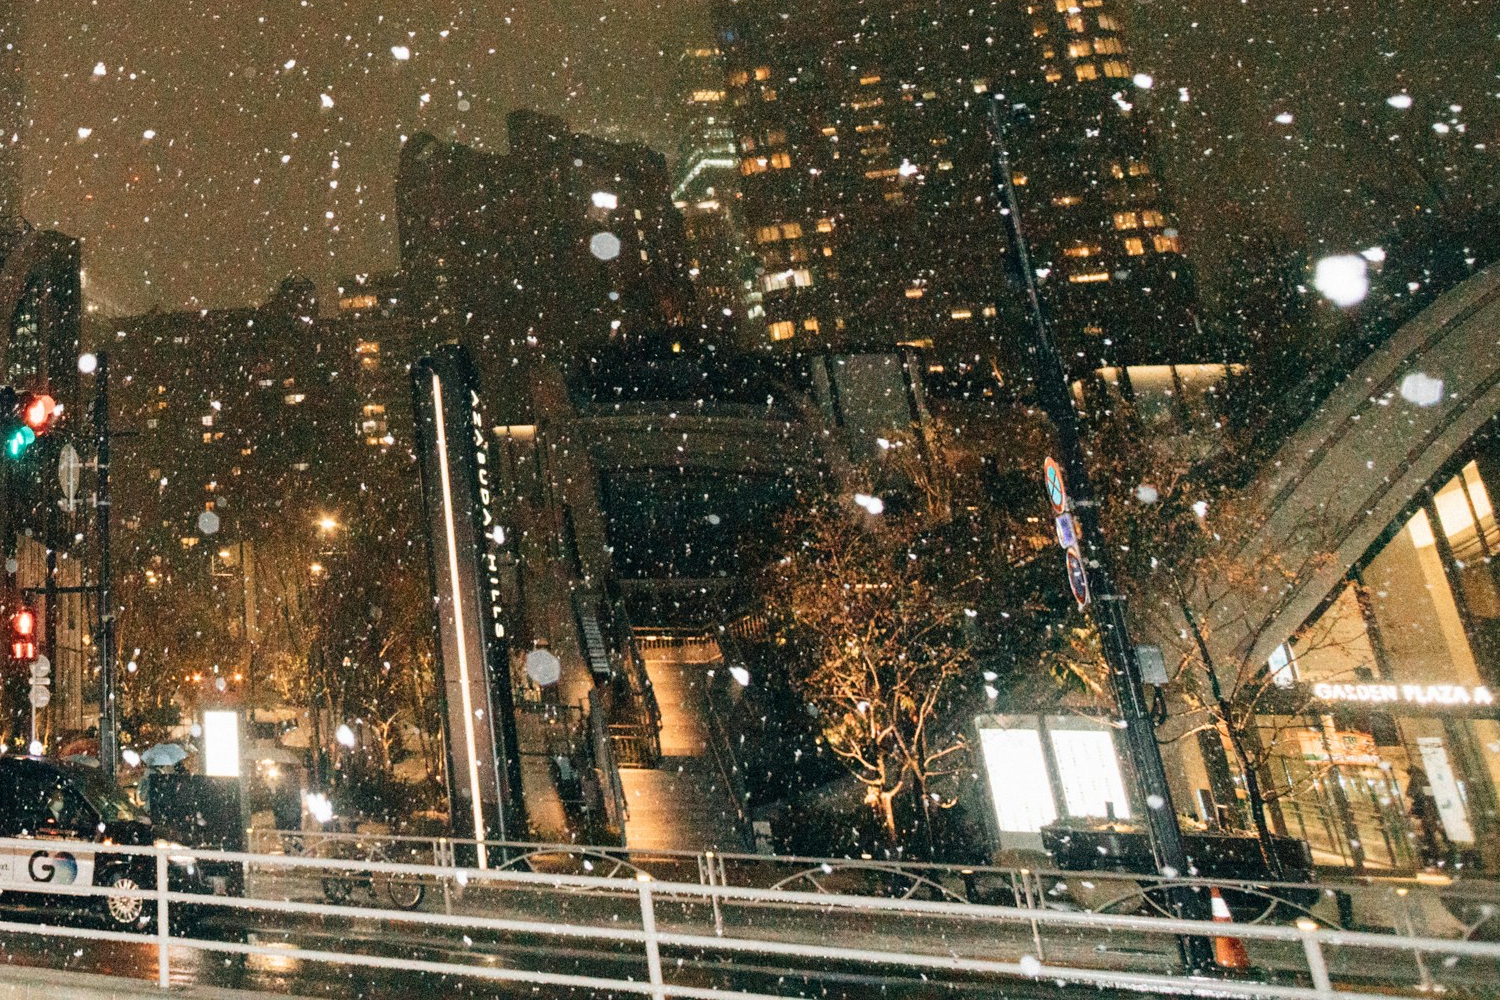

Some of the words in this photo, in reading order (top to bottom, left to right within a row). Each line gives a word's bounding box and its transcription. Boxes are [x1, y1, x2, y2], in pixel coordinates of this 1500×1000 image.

[470, 389, 494, 540] AZABUDAI
[488, 553, 505, 638] HILLS
[1402, 684, 1471, 704] PLAZA
